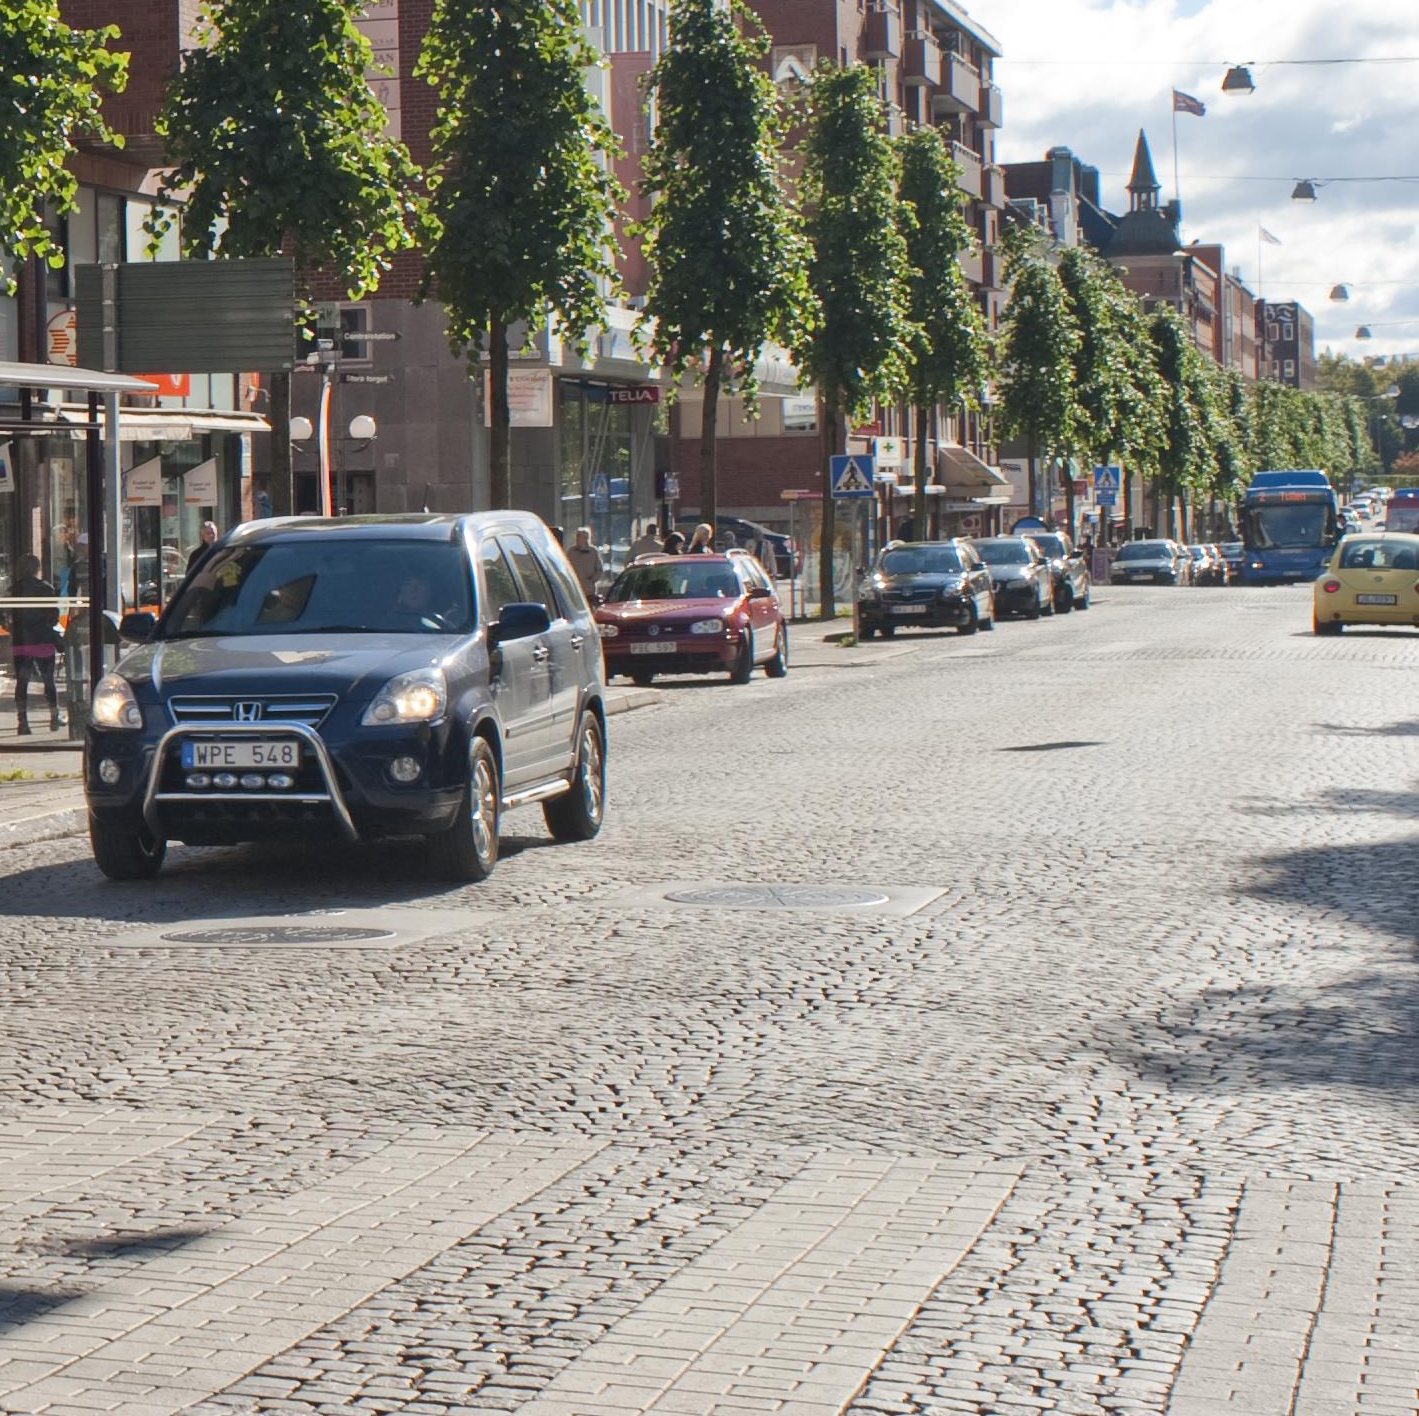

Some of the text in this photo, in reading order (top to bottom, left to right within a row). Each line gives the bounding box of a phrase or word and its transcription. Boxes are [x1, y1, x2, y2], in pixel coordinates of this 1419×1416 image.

[609, 390, 653, 401] TELIA
[196, 745, 293, 764] WPE 548
